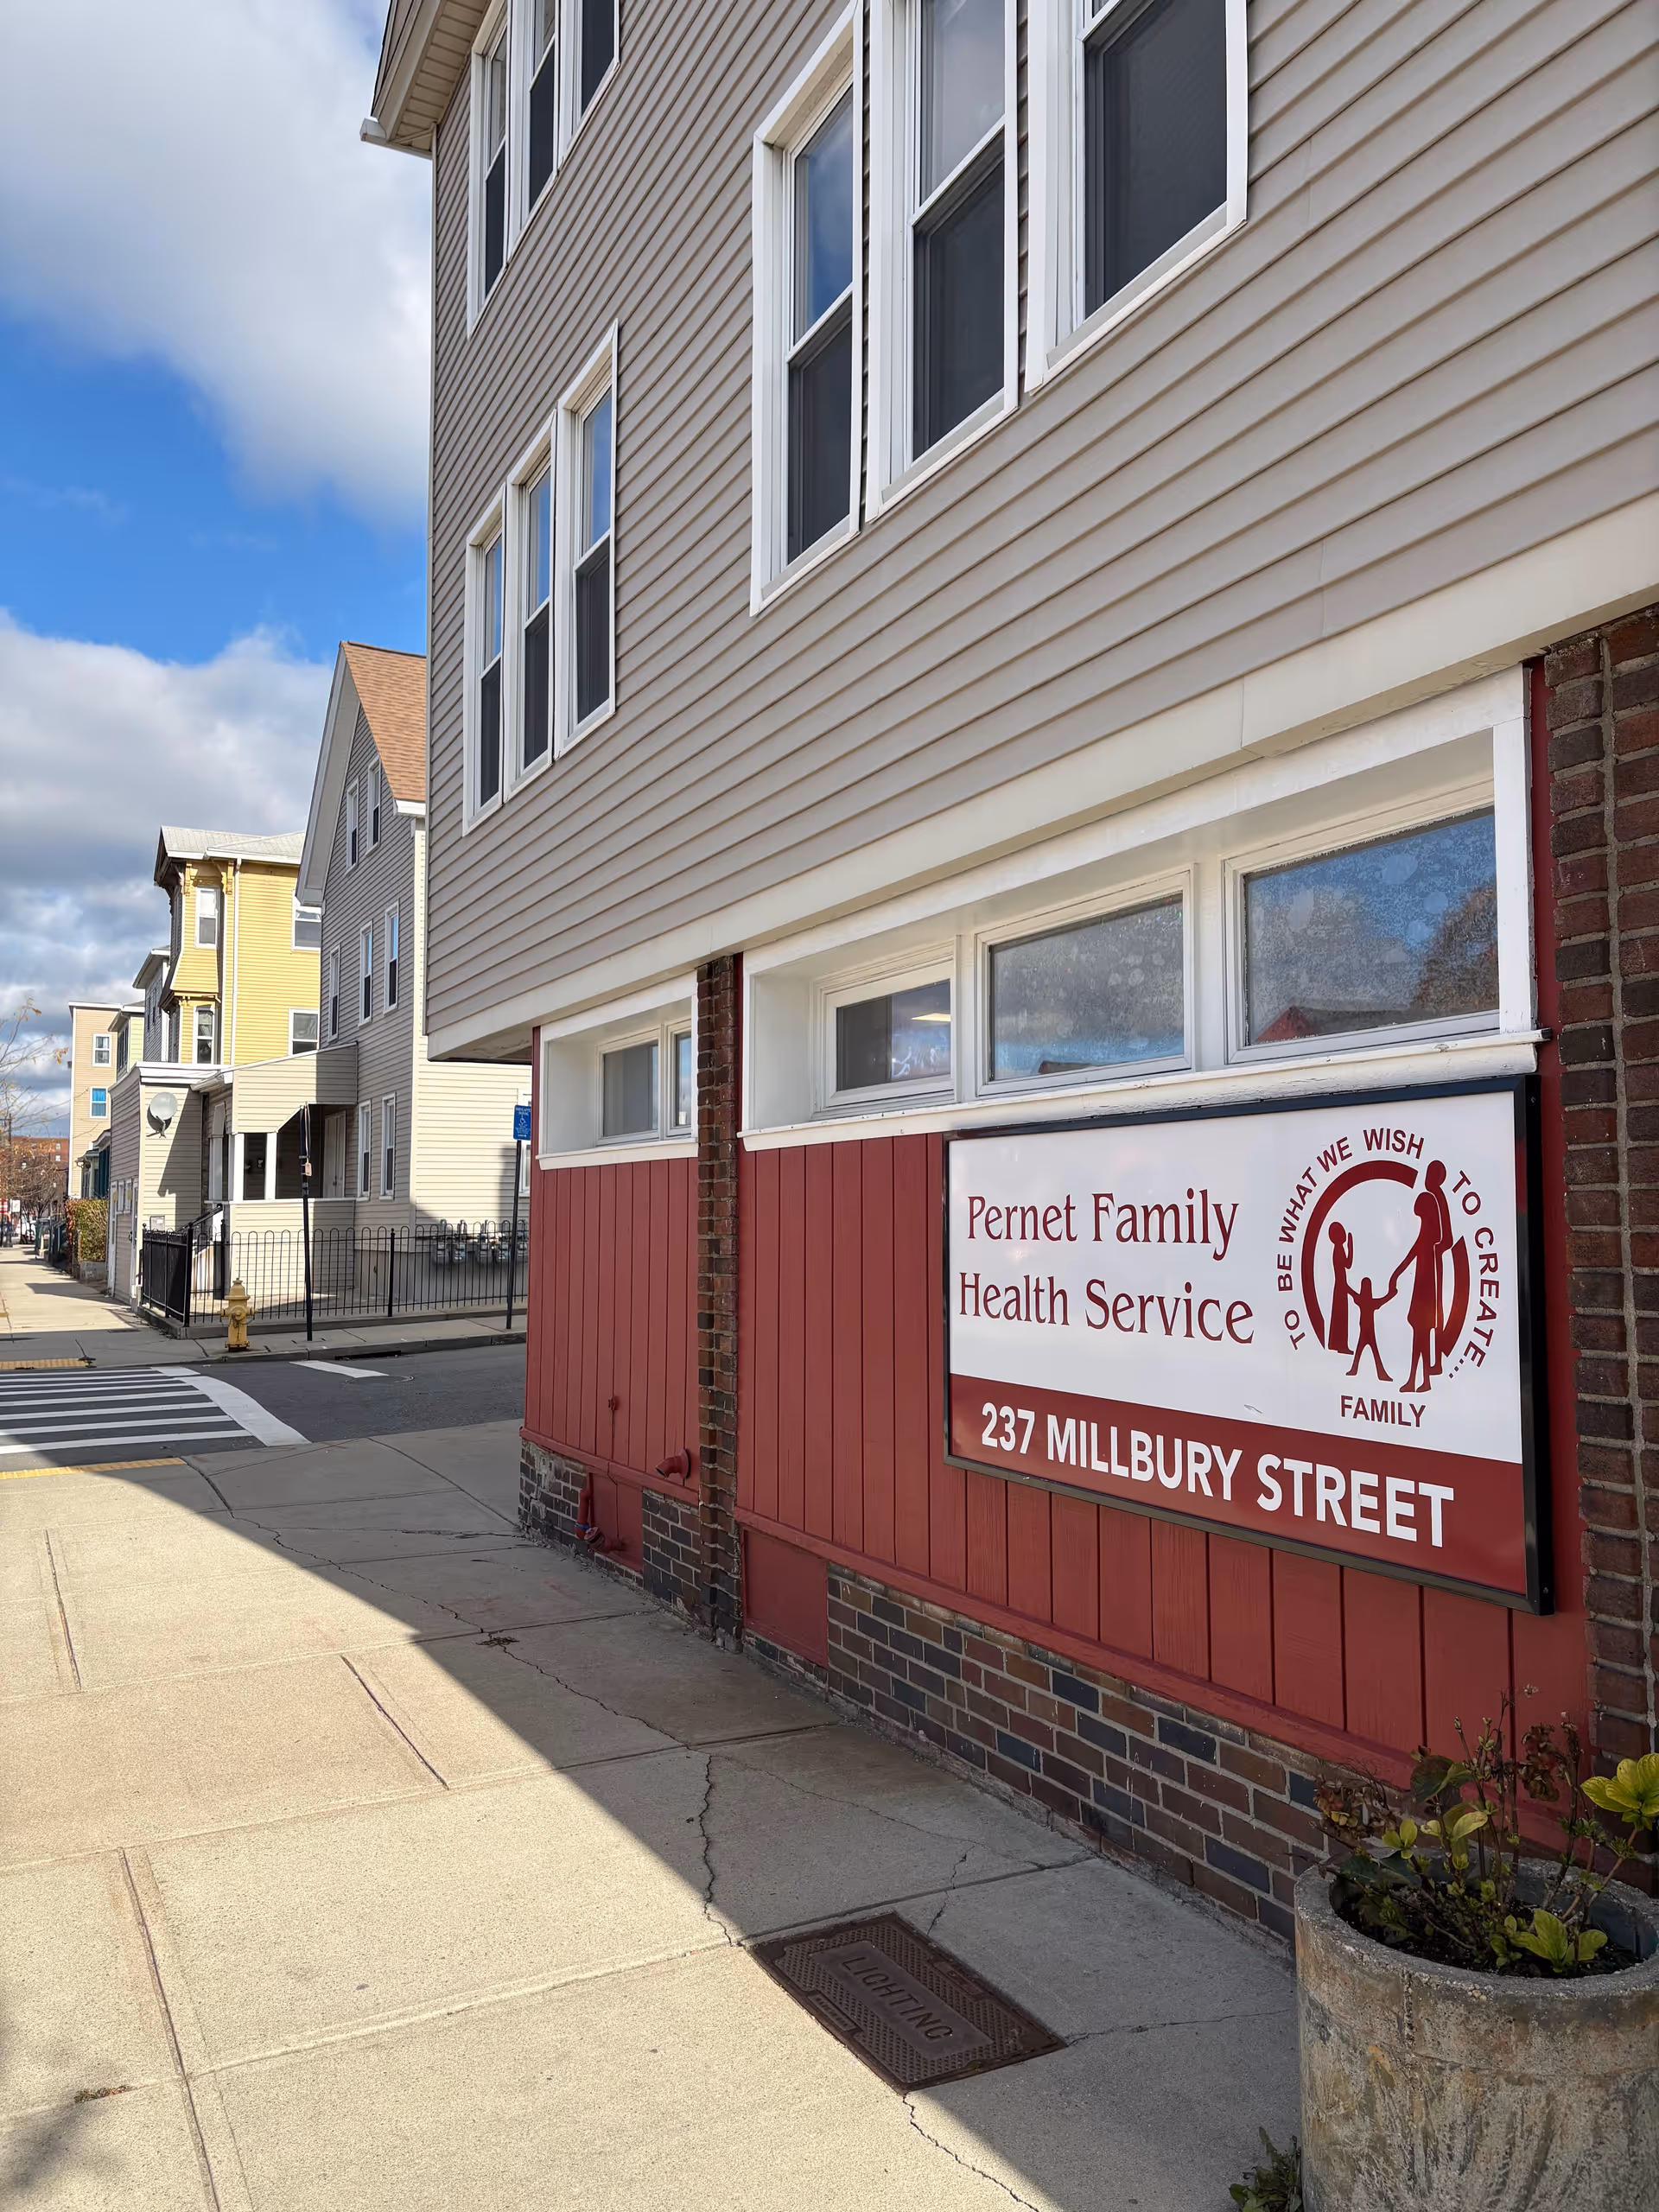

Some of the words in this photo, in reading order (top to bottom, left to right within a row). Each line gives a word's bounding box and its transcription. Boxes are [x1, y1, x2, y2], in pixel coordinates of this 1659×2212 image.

[1317, 1137, 1353, 1172] WE
[1363, 1127, 1424, 1160] WISH
[1279, 1166, 1318, 1243] WHAT
[1452, 1171, 1482, 1216] TO
[967, 1195, 1078, 1243] Pernet
[1091, 1187, 1240, 1261] Family
[1277, 1253, 1294, 1291] BE
[958, 1272, 1071, 1326] Health
[1085, 1279, 1255, 1344] Service
[1285, 1309, 1306, 1350] TO
[1447, 1227, 1500, 1379] CREATE...
[1341, 1395, 1426, 1428] FAMILY
[982, 1402, 1035, 1454] 237
[1047, 1414, 1243, 1502] MILLBURY
[1256, 1453, 1454, 1548] STREET
[842, 1955, 954, 2042] LIGHTING
